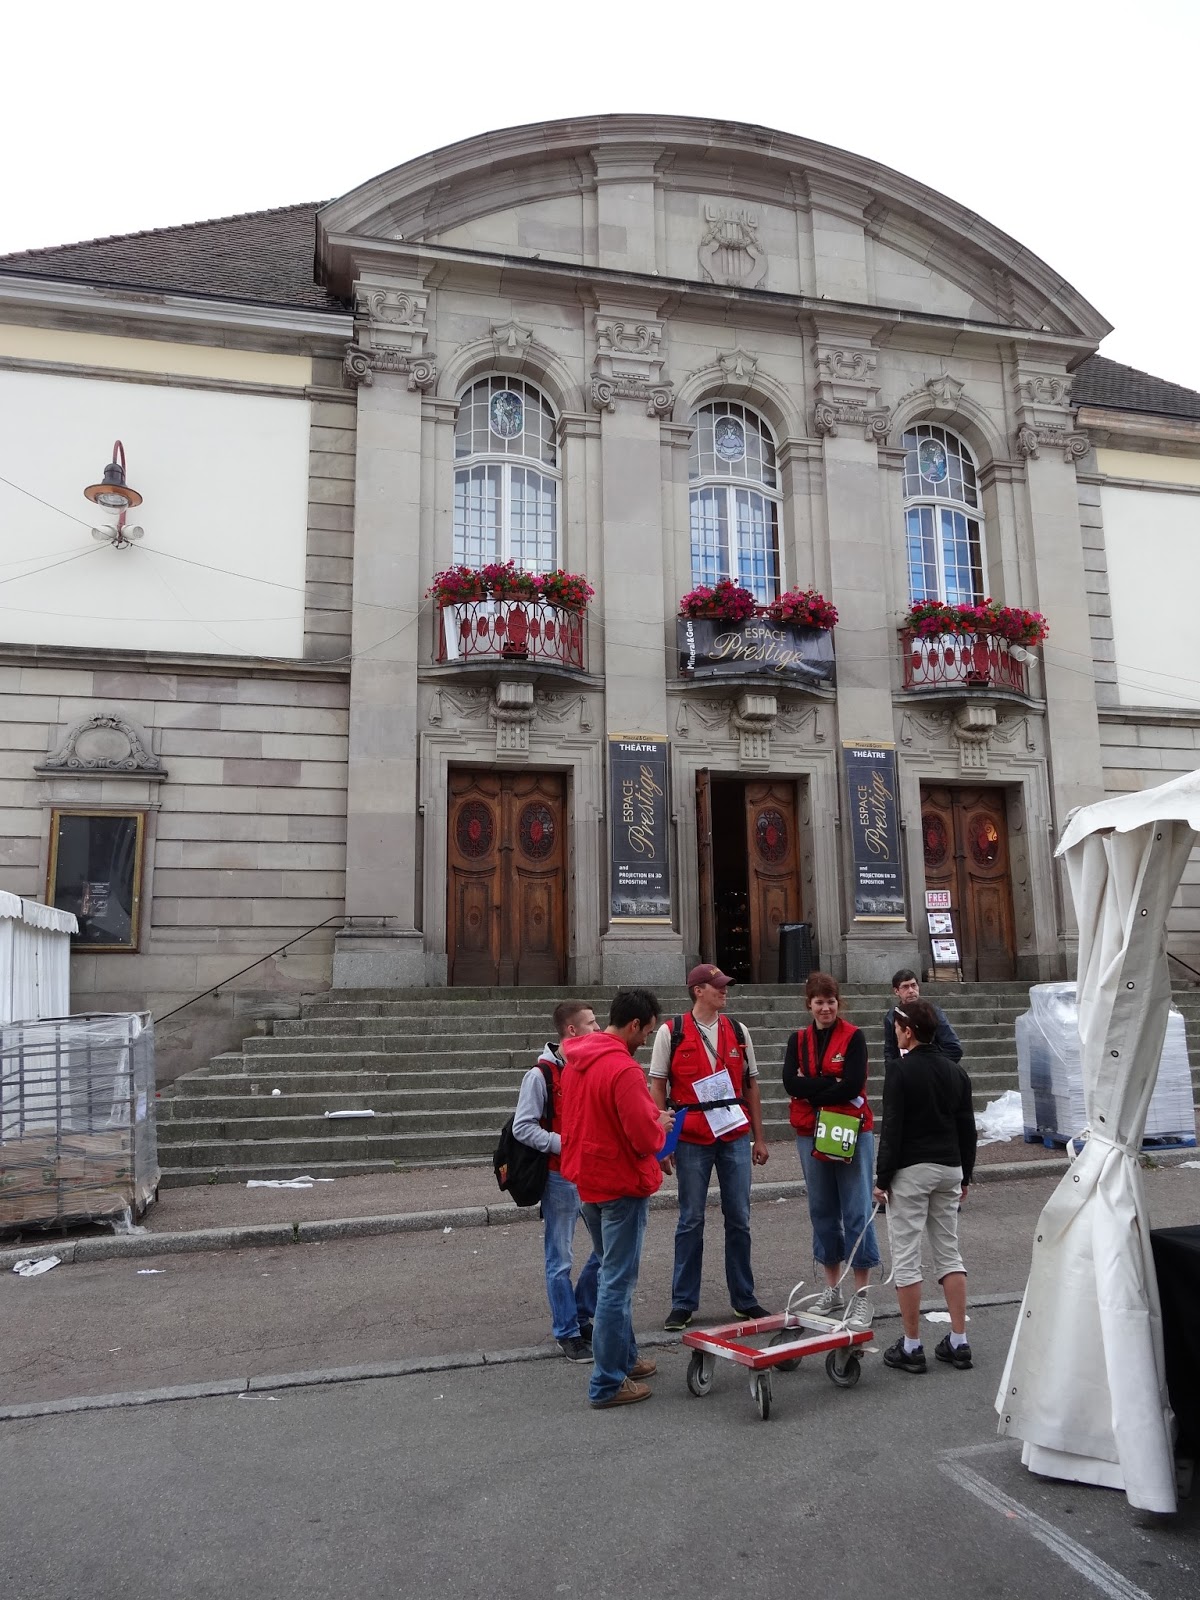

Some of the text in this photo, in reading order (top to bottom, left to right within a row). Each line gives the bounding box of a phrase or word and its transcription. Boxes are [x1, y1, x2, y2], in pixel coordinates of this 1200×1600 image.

[686, 620, 695, 670] Mineral&Gem
[708, 632, 804, 672] Prestige
[744, 627, 787, 642] ESPACE
[623, 780, 633, 822] ESPACE
[628, 765, 663, 859] Prestige
[858, 785, 869, 825] ESPACE
[865, 770, 893, 860] Prestige
[928, 893, 947, 902] FREE
